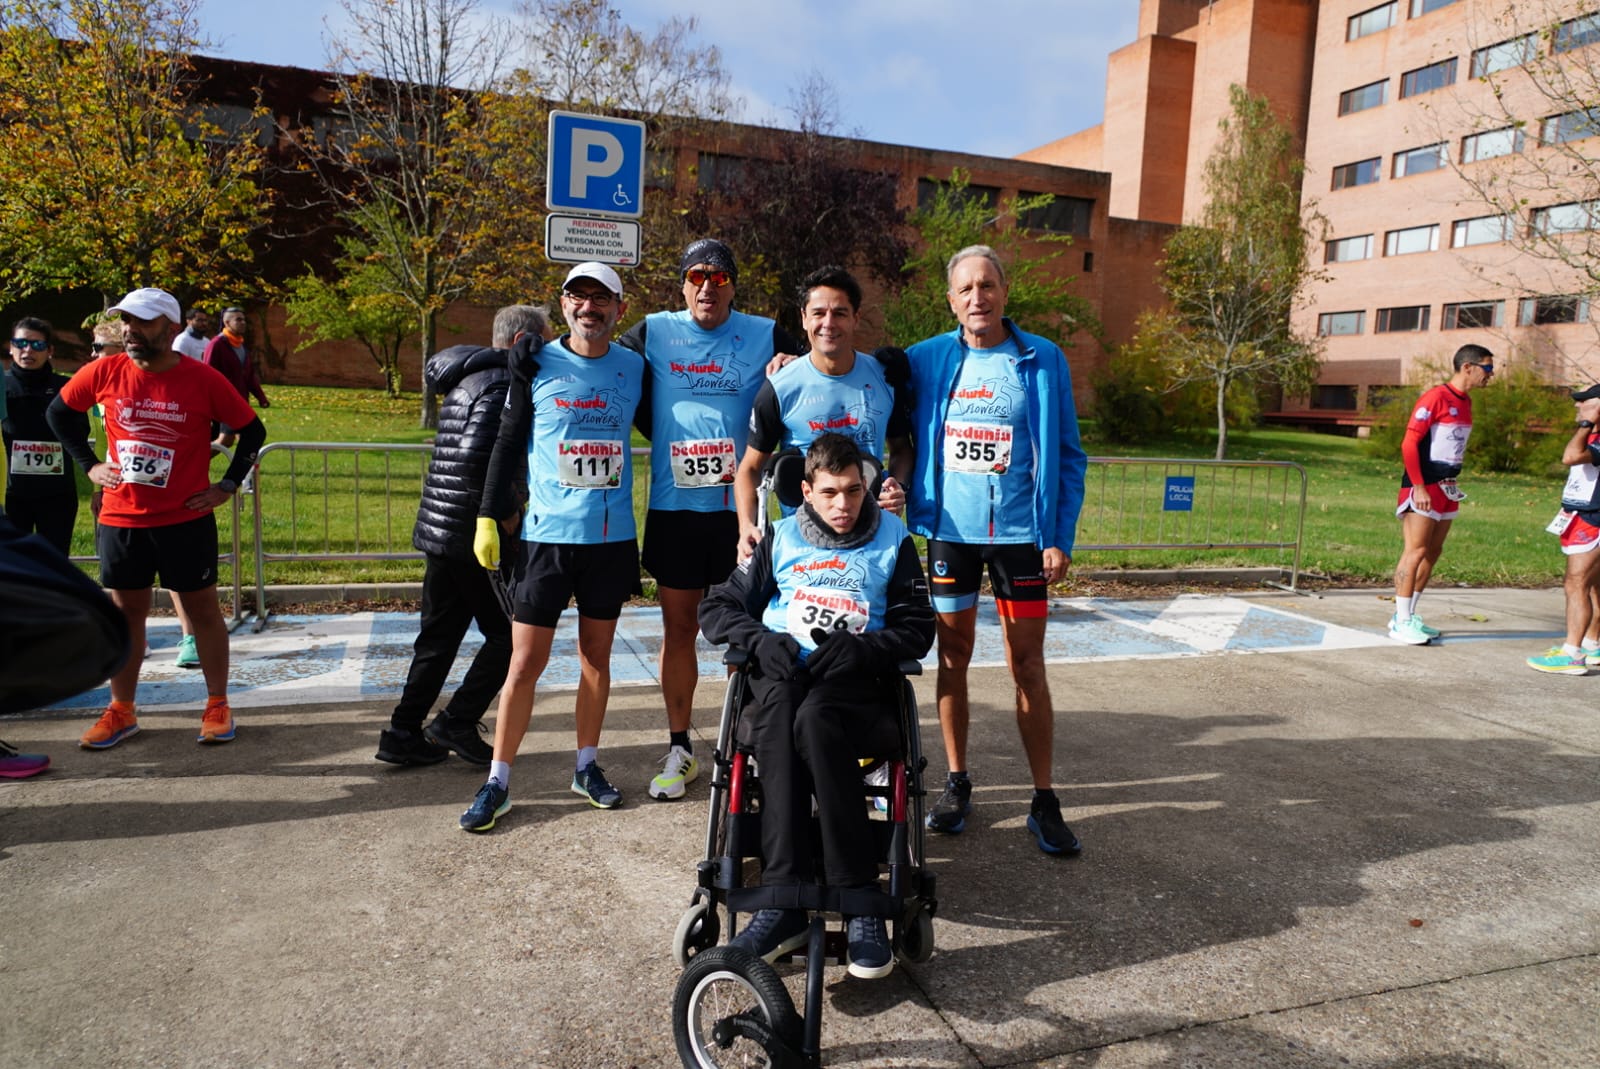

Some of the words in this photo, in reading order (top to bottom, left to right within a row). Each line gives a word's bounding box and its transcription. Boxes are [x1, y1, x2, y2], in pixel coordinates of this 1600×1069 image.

[569, 127, 624, 199] P
[572, 219, 617, 230] RESERVADO
[564, 236, 605, 246] PERSONAS
[606, 240, 623, 248] CON
[611, 231, 621, 239] DE
[553, 245, 595, 255] MOVILIDAD
[595, 249, 634, 258] REDUCIDA
[168, 401, 179, 411] sin
[946, 425, 1011, 442] bedunia
[13, 442, 61, 453] bedunia
[559, 443, 621, 455] bedunia
[671, 441, 733, 457] bedunia
[955, 441, 996, 462] 355
[23, 453, 53, 466] 190
[123, 456, 156, 475] 256
[573, 457, 610, 476] 111
[684, 456, 723, 476] 353
[802, 605, 849, 631] 356
